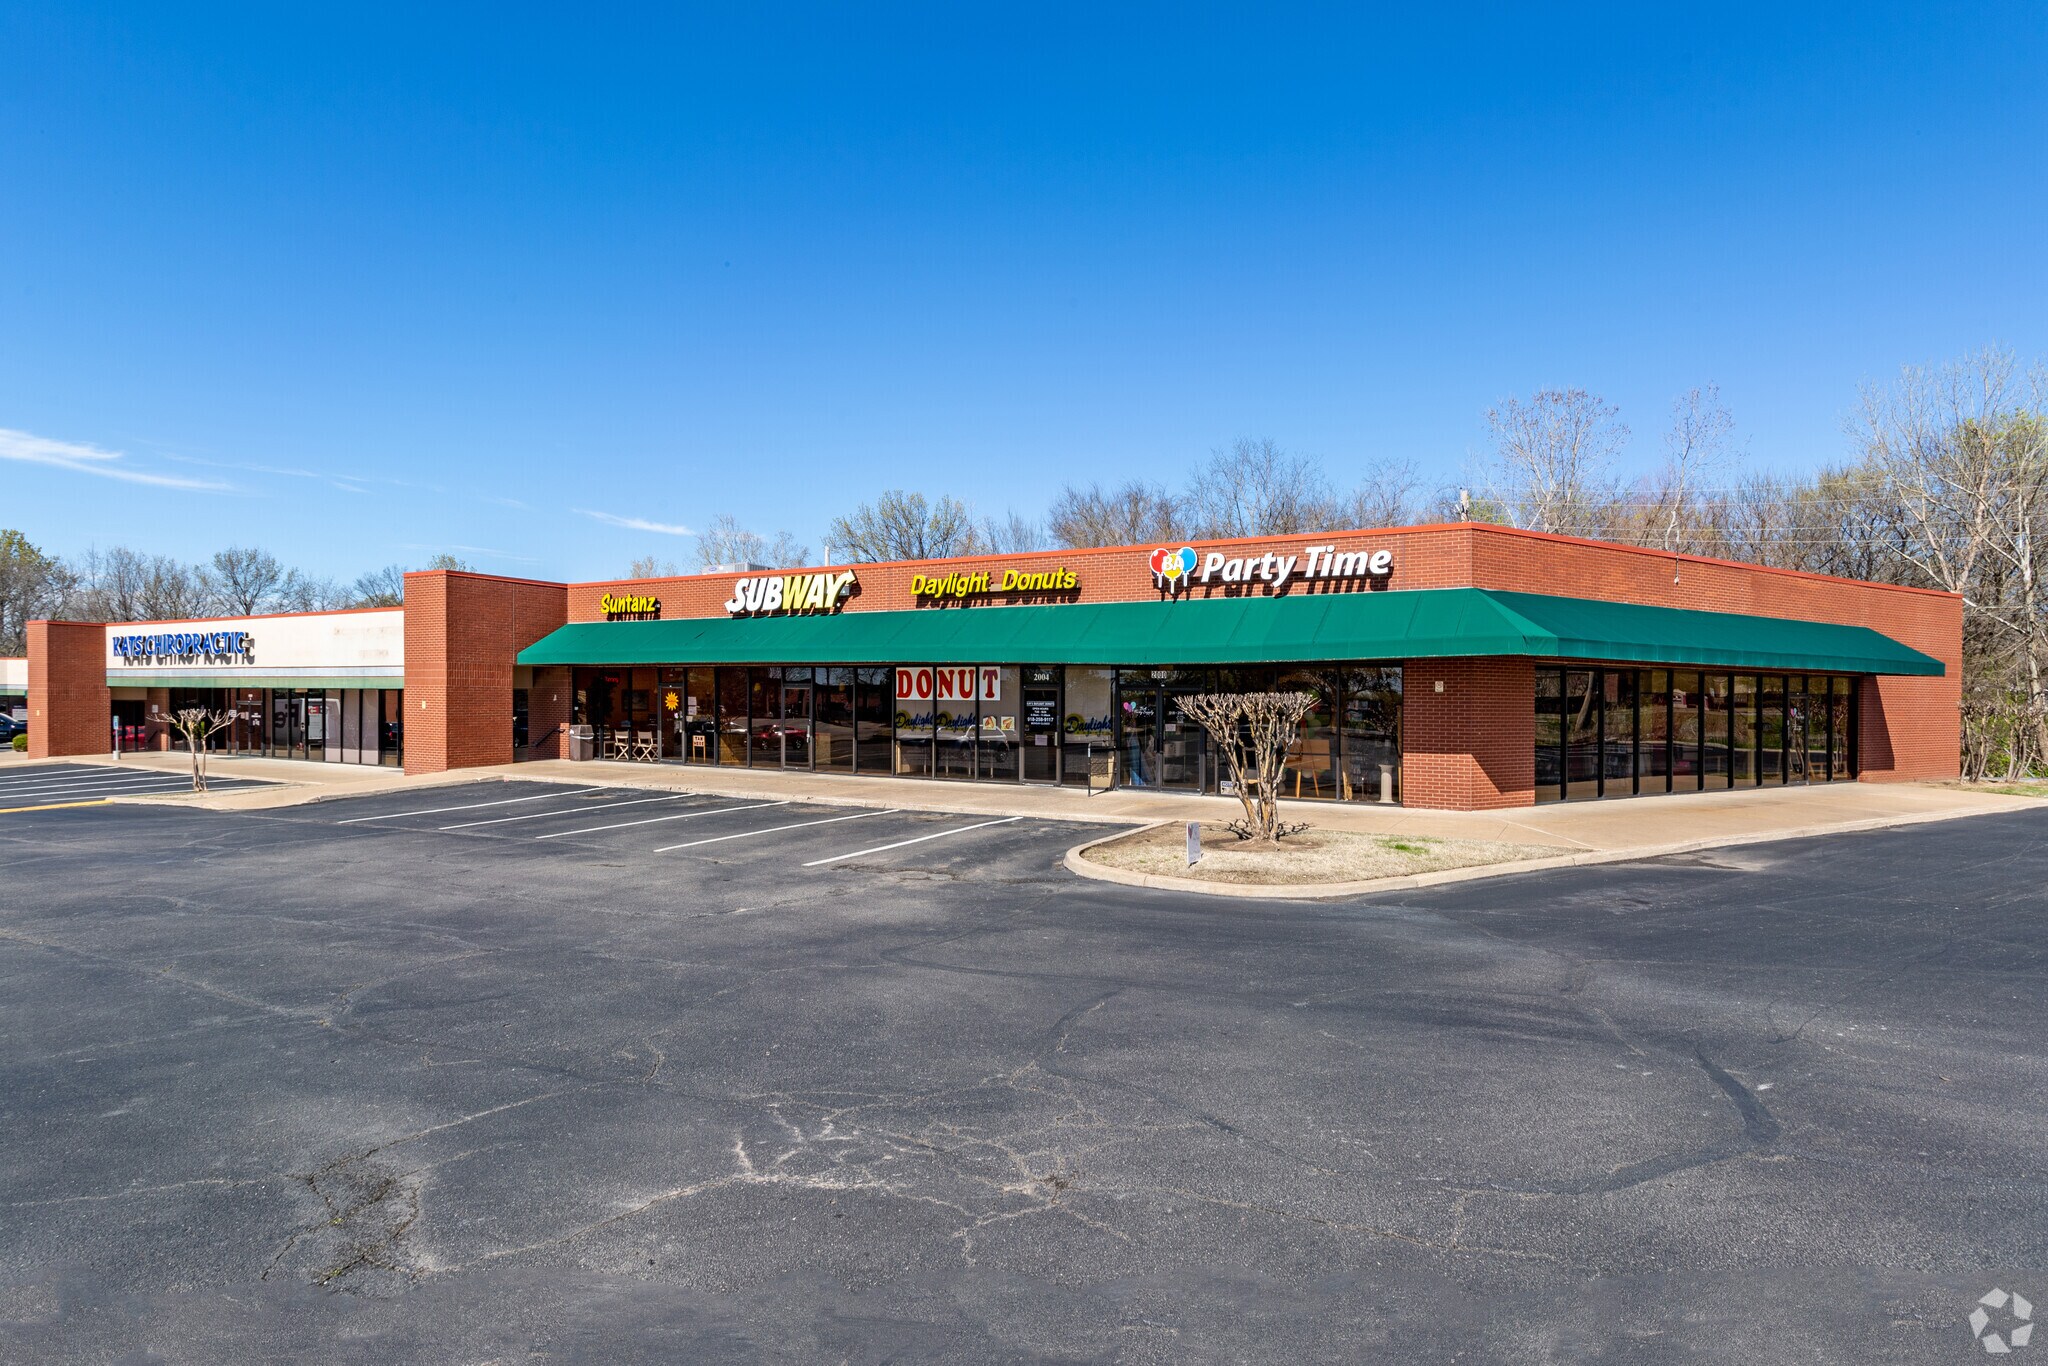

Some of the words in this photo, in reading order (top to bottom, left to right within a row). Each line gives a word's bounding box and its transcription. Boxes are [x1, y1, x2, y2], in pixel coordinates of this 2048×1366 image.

[1162, 555, 1184, 571] BA
[1200, 551, 1297, 588] Party
[1305, 544, 1392, 578] Time
[724, 569, 857, 614] SUBWAY
[911, 571, 990, 598] Daylight
[1001, 566, 1078, 591] Donuts
[600, 592, 656, 614] Suntanz
[112, 635, 143, 657] KATS
[144, 631, 246, 656] CHIROPRACTIC
[896, 668, 999, 699] DONUT
[1033, 673, 1050, 681] 2004
[1065, 714, 1112, 737] Daylight
